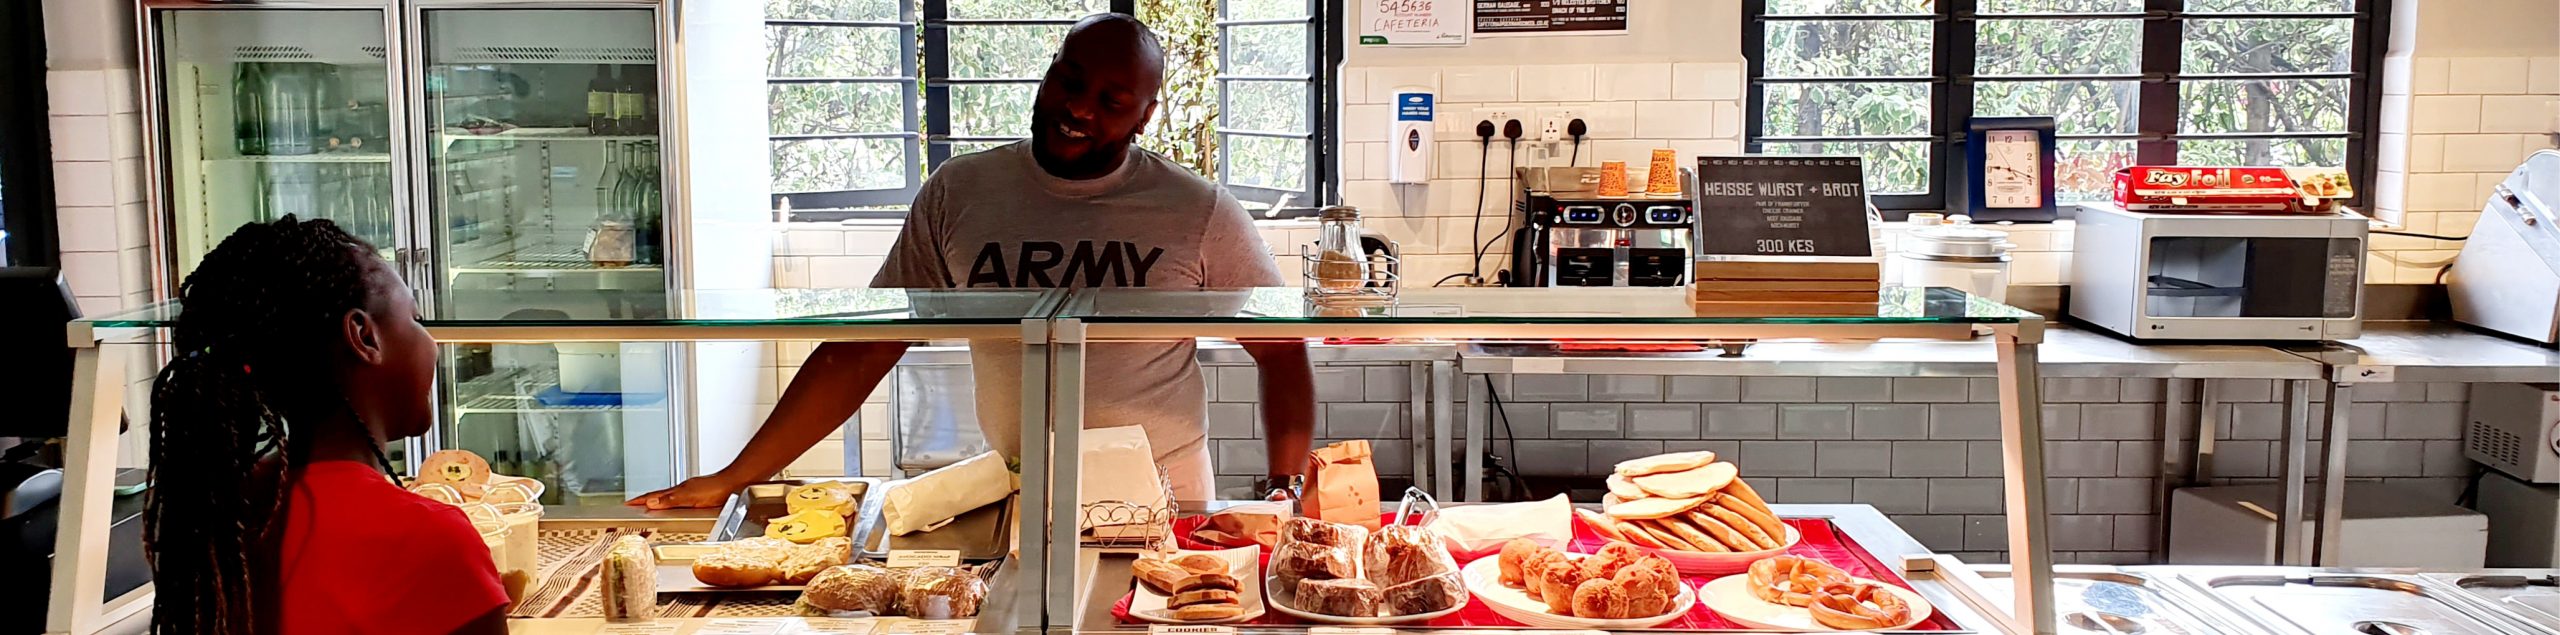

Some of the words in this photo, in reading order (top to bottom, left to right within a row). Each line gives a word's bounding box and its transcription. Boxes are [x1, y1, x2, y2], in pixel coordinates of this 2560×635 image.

[1374, 17, 1440, 32] CAFETERIA
[2146, 169, 2189, 186] Fay
[2190, 168, 2231, 187] Foil
[1704, 182, 1754, 196] HEISSE
[1758, 182, 1804, 196] WURST
[1822, 183, 1860, 197] BROT
[1757, 239, 1784, 253] 300
[1788, 239, 1815, 253] KES
[966, 240, 1165, 288] ARMY
